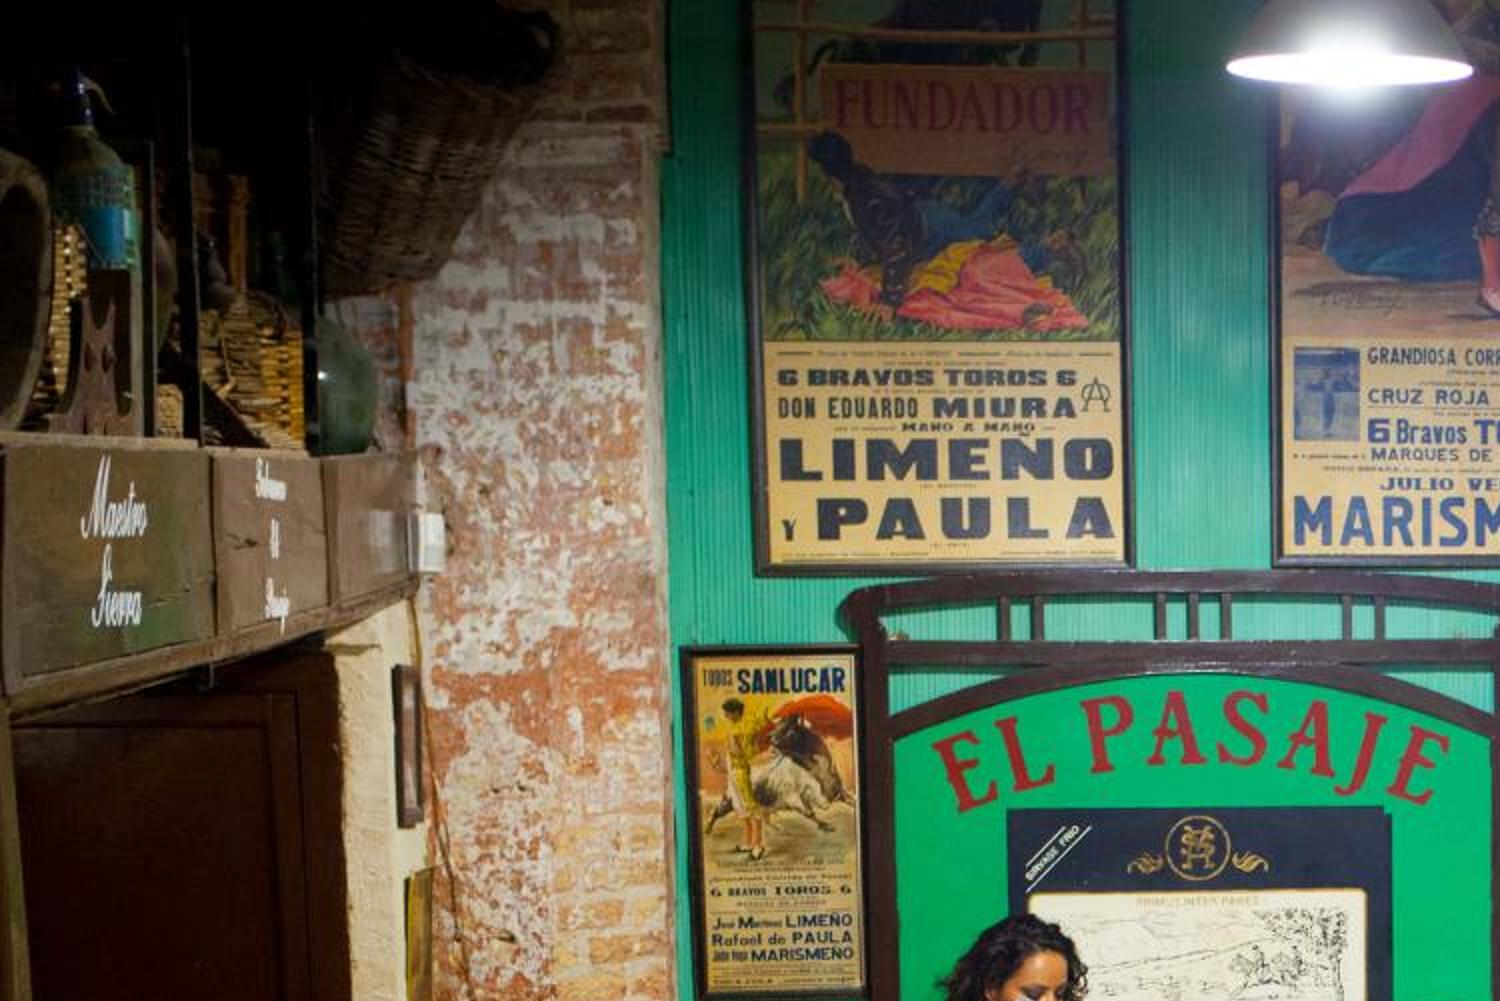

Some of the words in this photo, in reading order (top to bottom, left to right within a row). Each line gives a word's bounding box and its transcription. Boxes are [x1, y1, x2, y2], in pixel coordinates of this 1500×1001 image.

[832, 77, 1092, 133] FUNDADOR
[1367, 347, 1456, 367] GRANDIOSA
[778, 368, 798, 386] 6
[808, 368, 934, 386] BRAVOS
[944, 368, 1047, 386] TOROS
[1056, 369, 1077, 386] 6
[1367, 387, 1424, 405] CRUZ
[1435, 389, 1490, 406] ROJA
[778, 397, 815, 419] DON
[828, 397, 918, 419] EDUARDO
[933, 397, 1077, 418] MIURA
[1367, 418, 1390, 443] 6
[1396, 420, 1467, 444] Bravos
[779, 431, 1114, 481] LIMEÑO
[1371, 448, 1459, 462] MARQUES
[1469, 450, 1492, 462] DE
[1380, 477, 1455, 491] JULIO
[782, 519, 796, 541] Y
[816, 497, 1115, 540] PAULA
[738, 667, 845, 693] SANLUCAR
[931, 714, 1056, 814] EL
[1081, 690, 1450, 805] PASAJE
[712, 932, 762, 947] Rafael
[768, 932, 786, 945] de
[792, 931, 853, 945] PAULA
